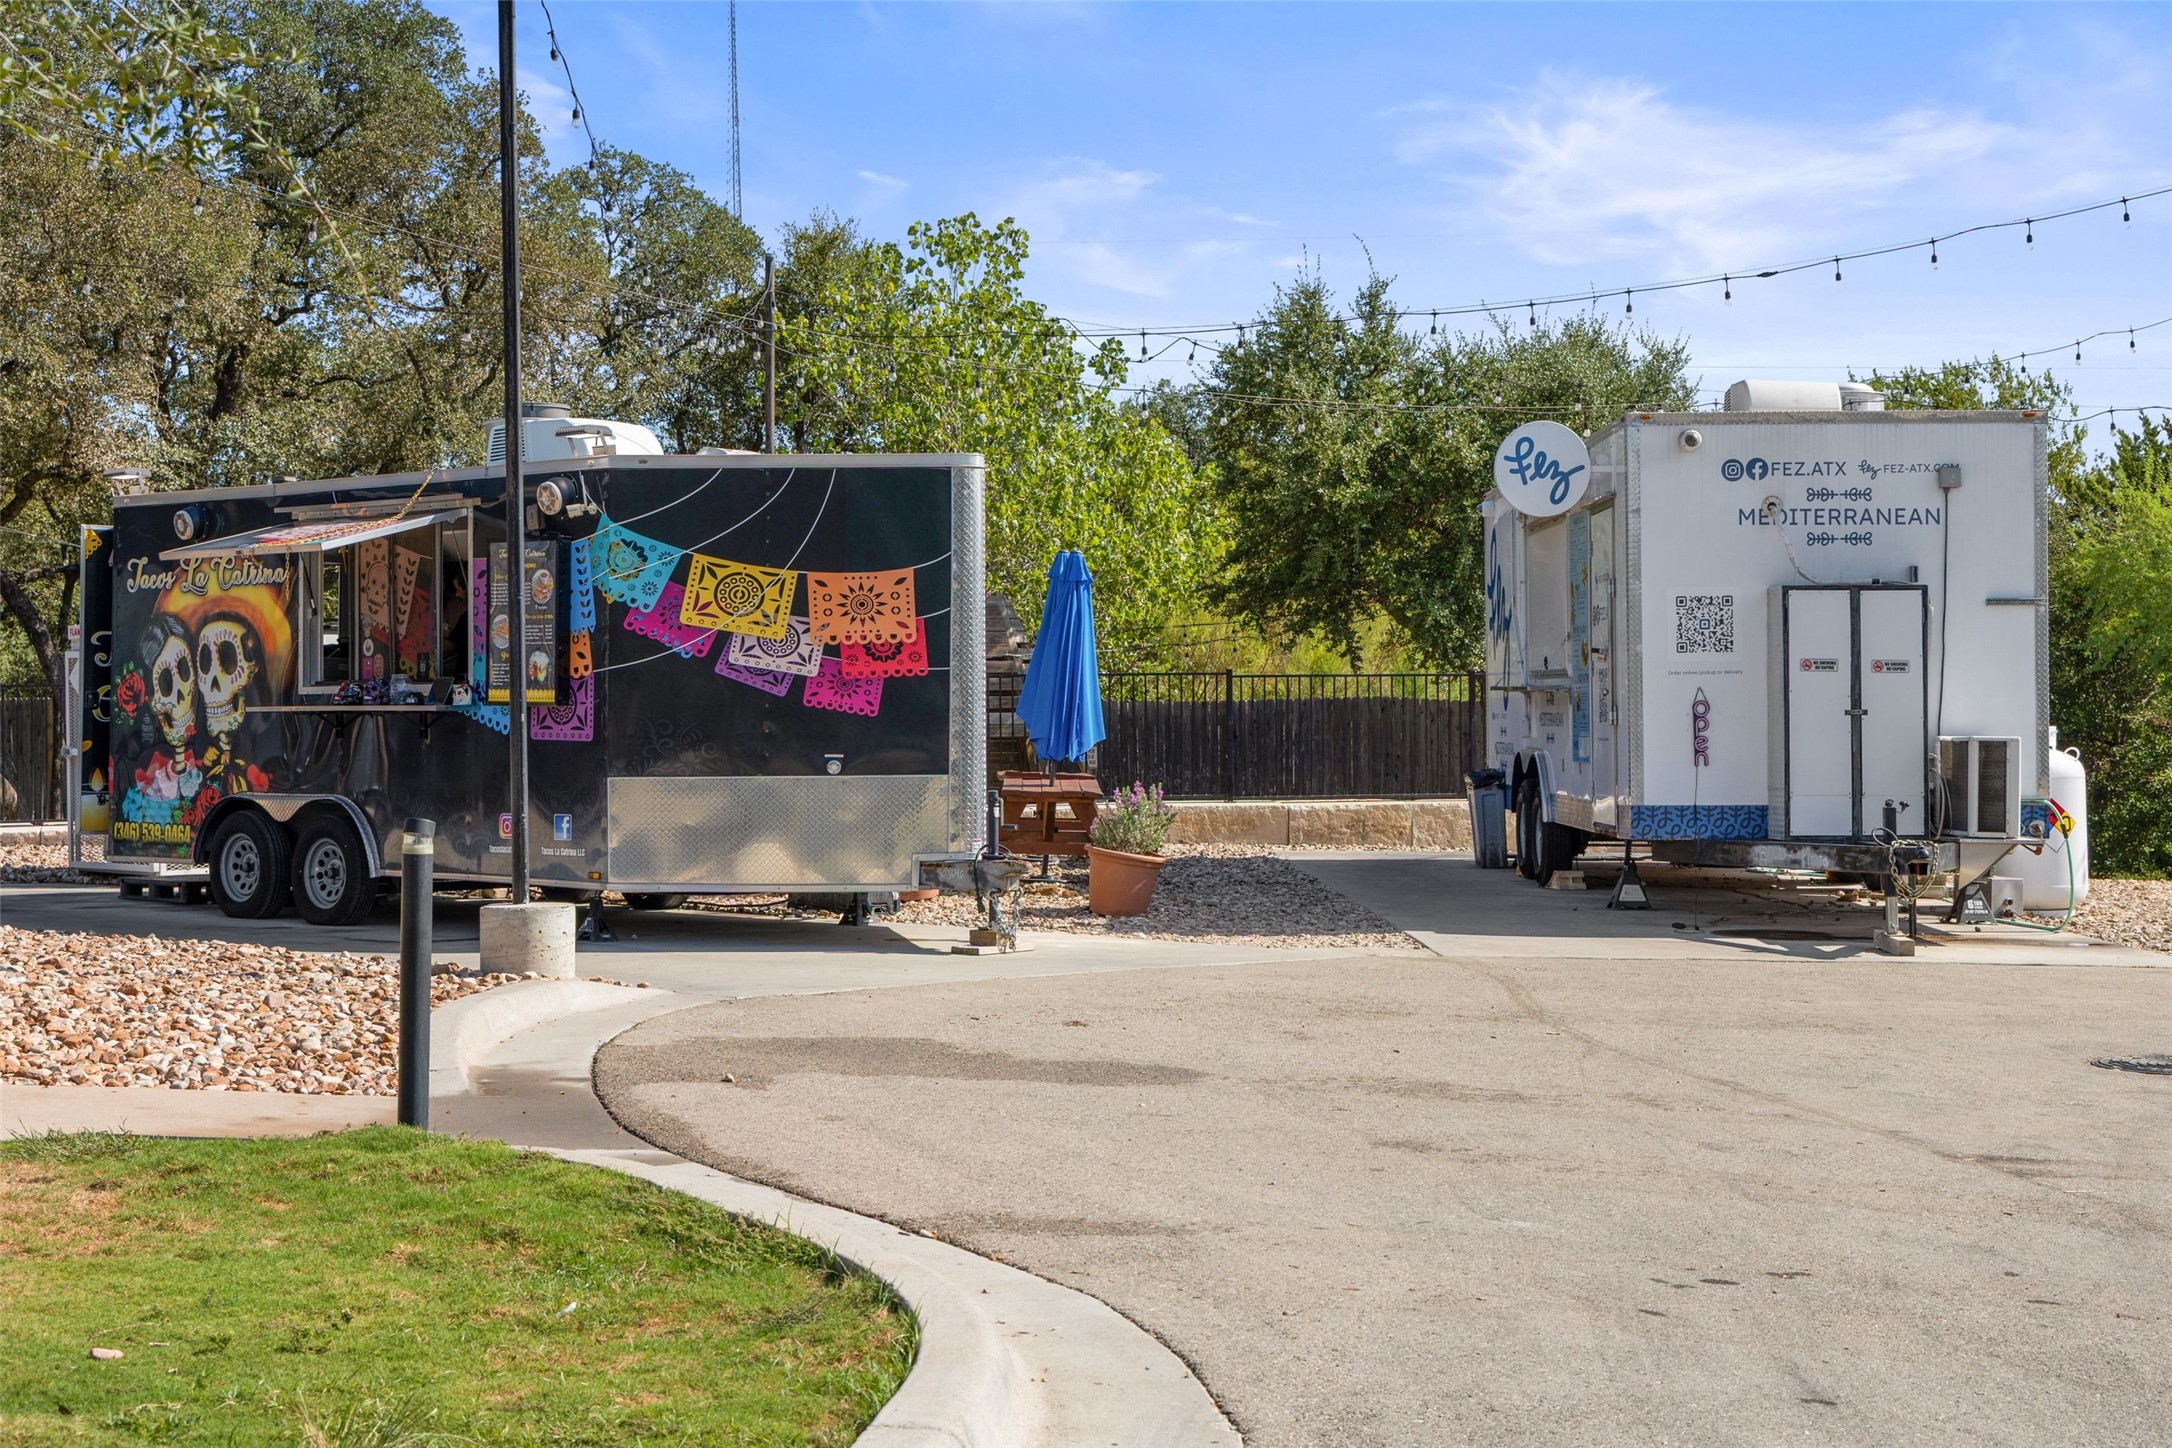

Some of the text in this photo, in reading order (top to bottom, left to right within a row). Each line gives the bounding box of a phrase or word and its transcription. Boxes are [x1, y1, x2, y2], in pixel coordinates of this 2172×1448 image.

[1770, 461, 1847, 477] FEZ.ATX
[127, 556, 287, 596] Tacos La Catrina
[114, 821, 191, 844] (346) 539-0464
[541, 847, 586, 857] Tacos La Catrina LLC
